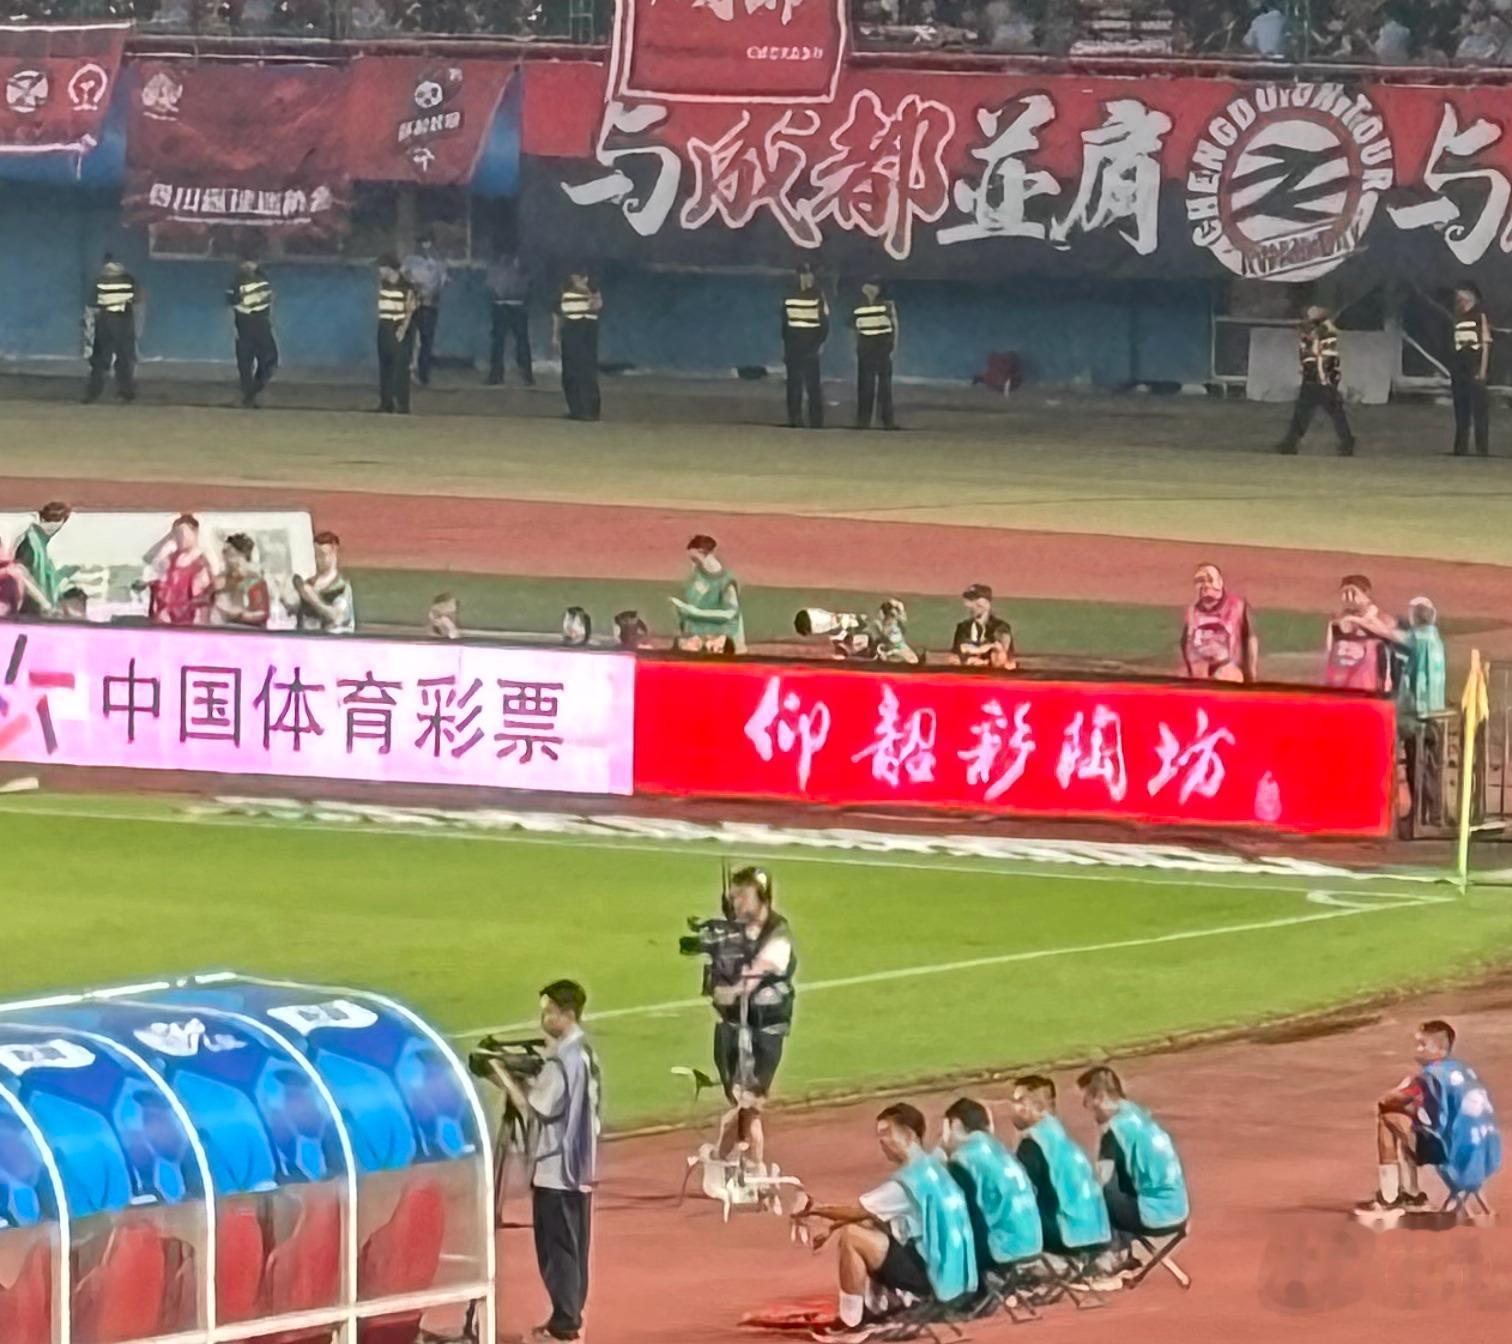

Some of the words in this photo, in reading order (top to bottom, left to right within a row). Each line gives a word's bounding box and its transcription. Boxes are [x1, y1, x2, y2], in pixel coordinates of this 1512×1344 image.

[102, 657, 565, 764] 中国体育彩票
[744, 674, 1236, 805] 仰韶彩陶坊
